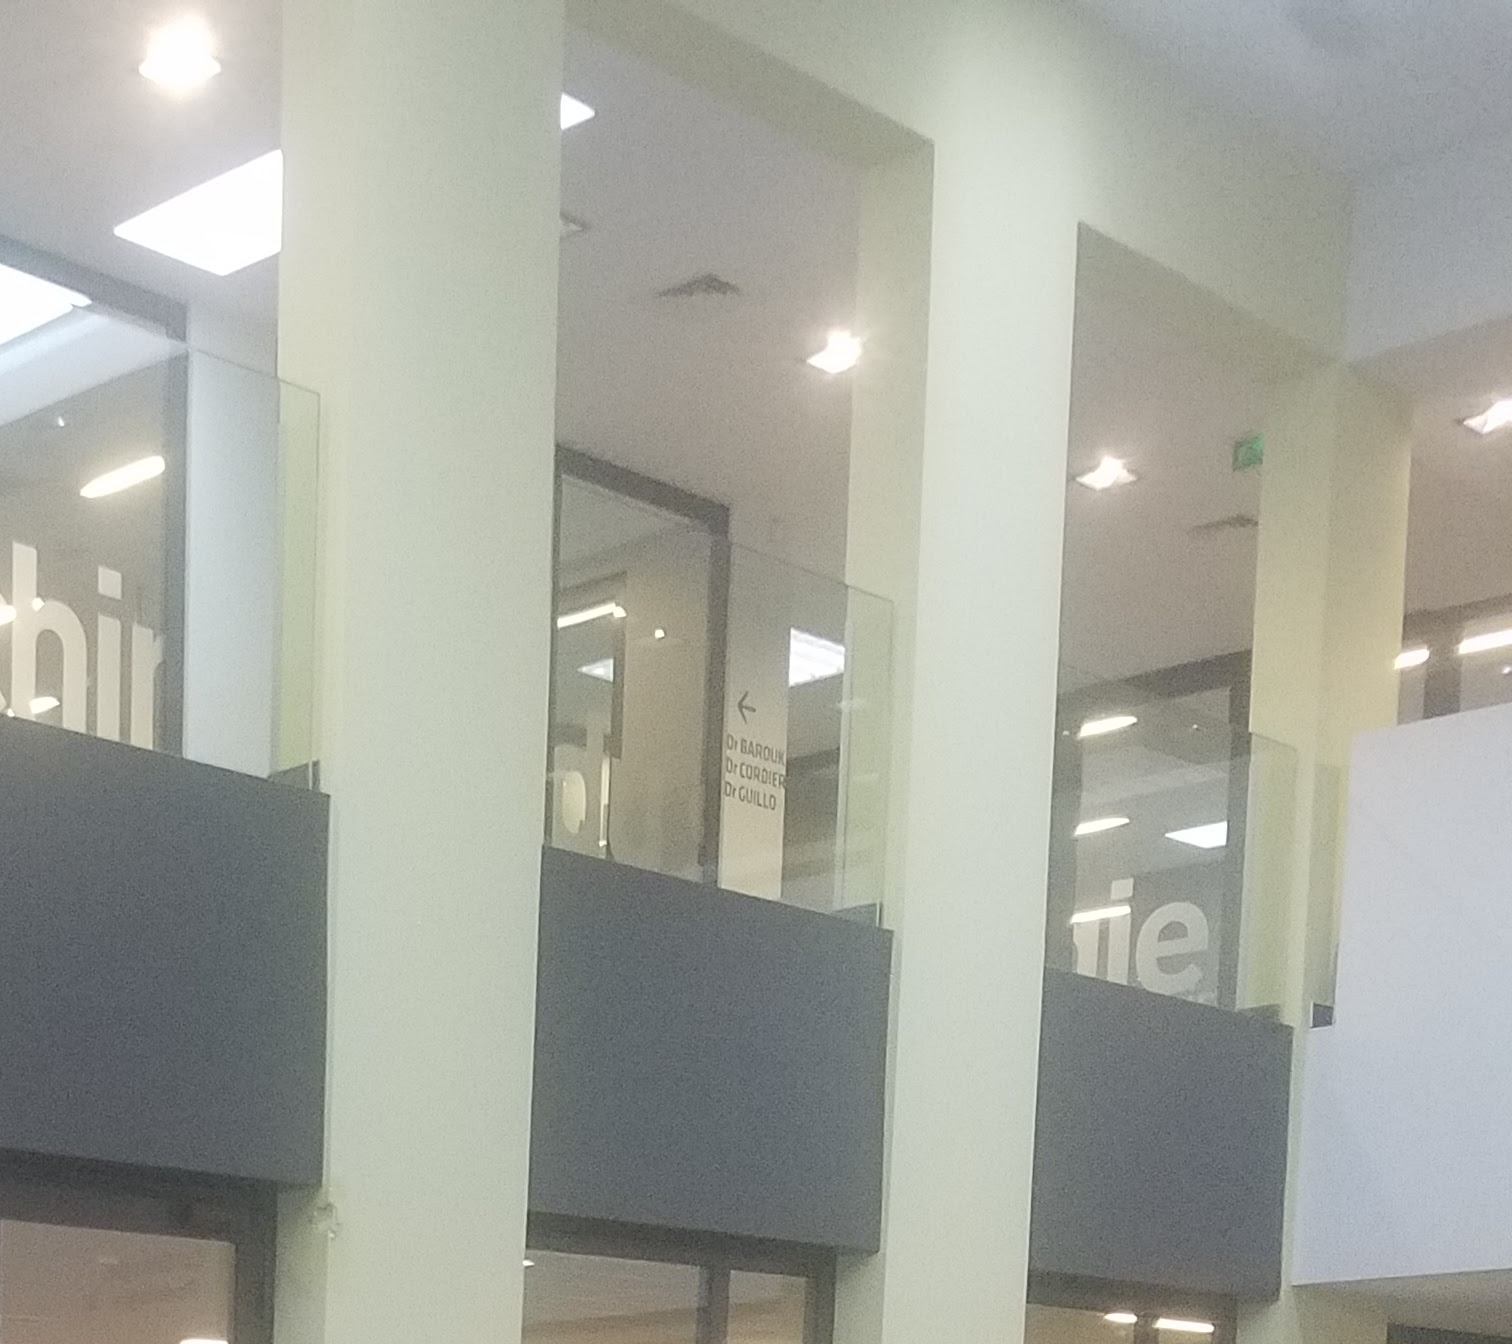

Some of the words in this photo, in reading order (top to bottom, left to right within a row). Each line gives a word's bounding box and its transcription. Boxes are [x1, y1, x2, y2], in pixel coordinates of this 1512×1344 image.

[740, 762, 788, 789] CORDIER
[724, 781, 737, 798] Dr
[738, 785, 777, 811] GUILLO
